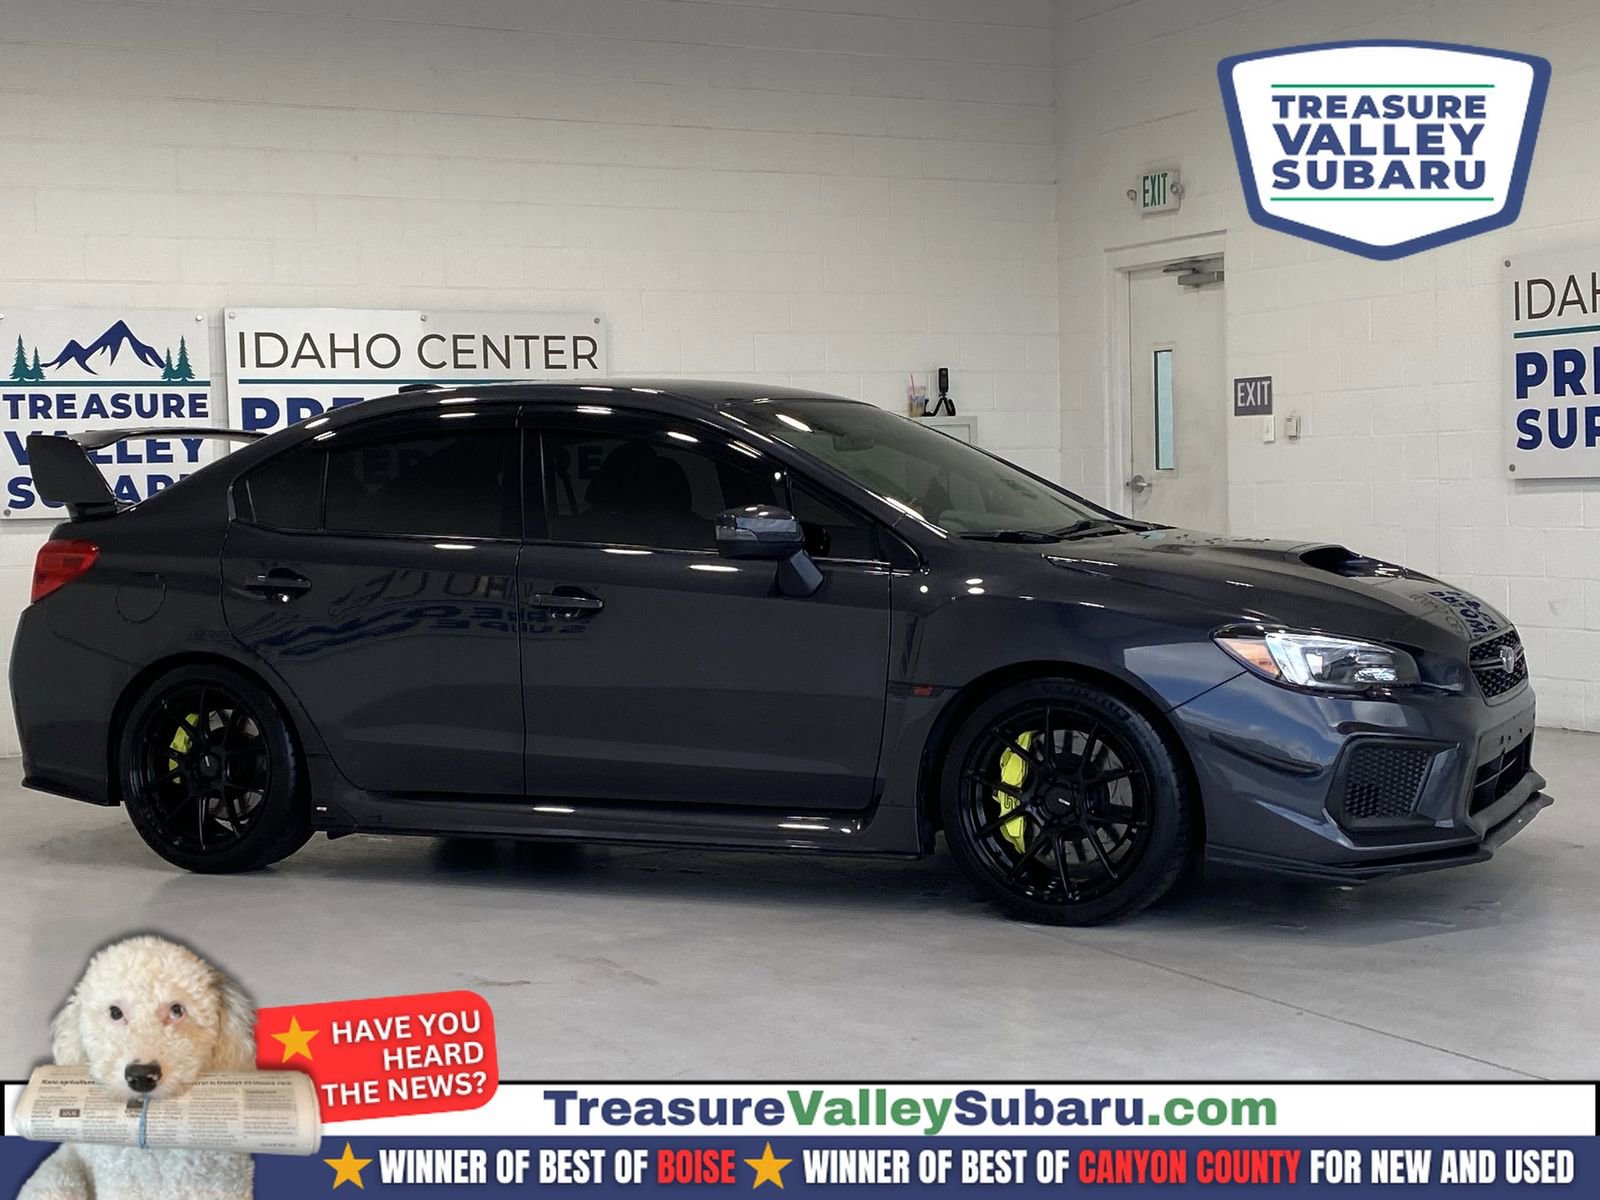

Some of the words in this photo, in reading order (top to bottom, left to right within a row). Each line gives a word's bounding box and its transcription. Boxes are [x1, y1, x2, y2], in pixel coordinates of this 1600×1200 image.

[1142, 172, 1168, 208] EXIT
[239, 332, 401, 369] IDAHO
[418, 334, 599, 370] CENTER
[2, 392, 209, 420] TREASURE
[1237, 380, 1271, 408] EXIT
